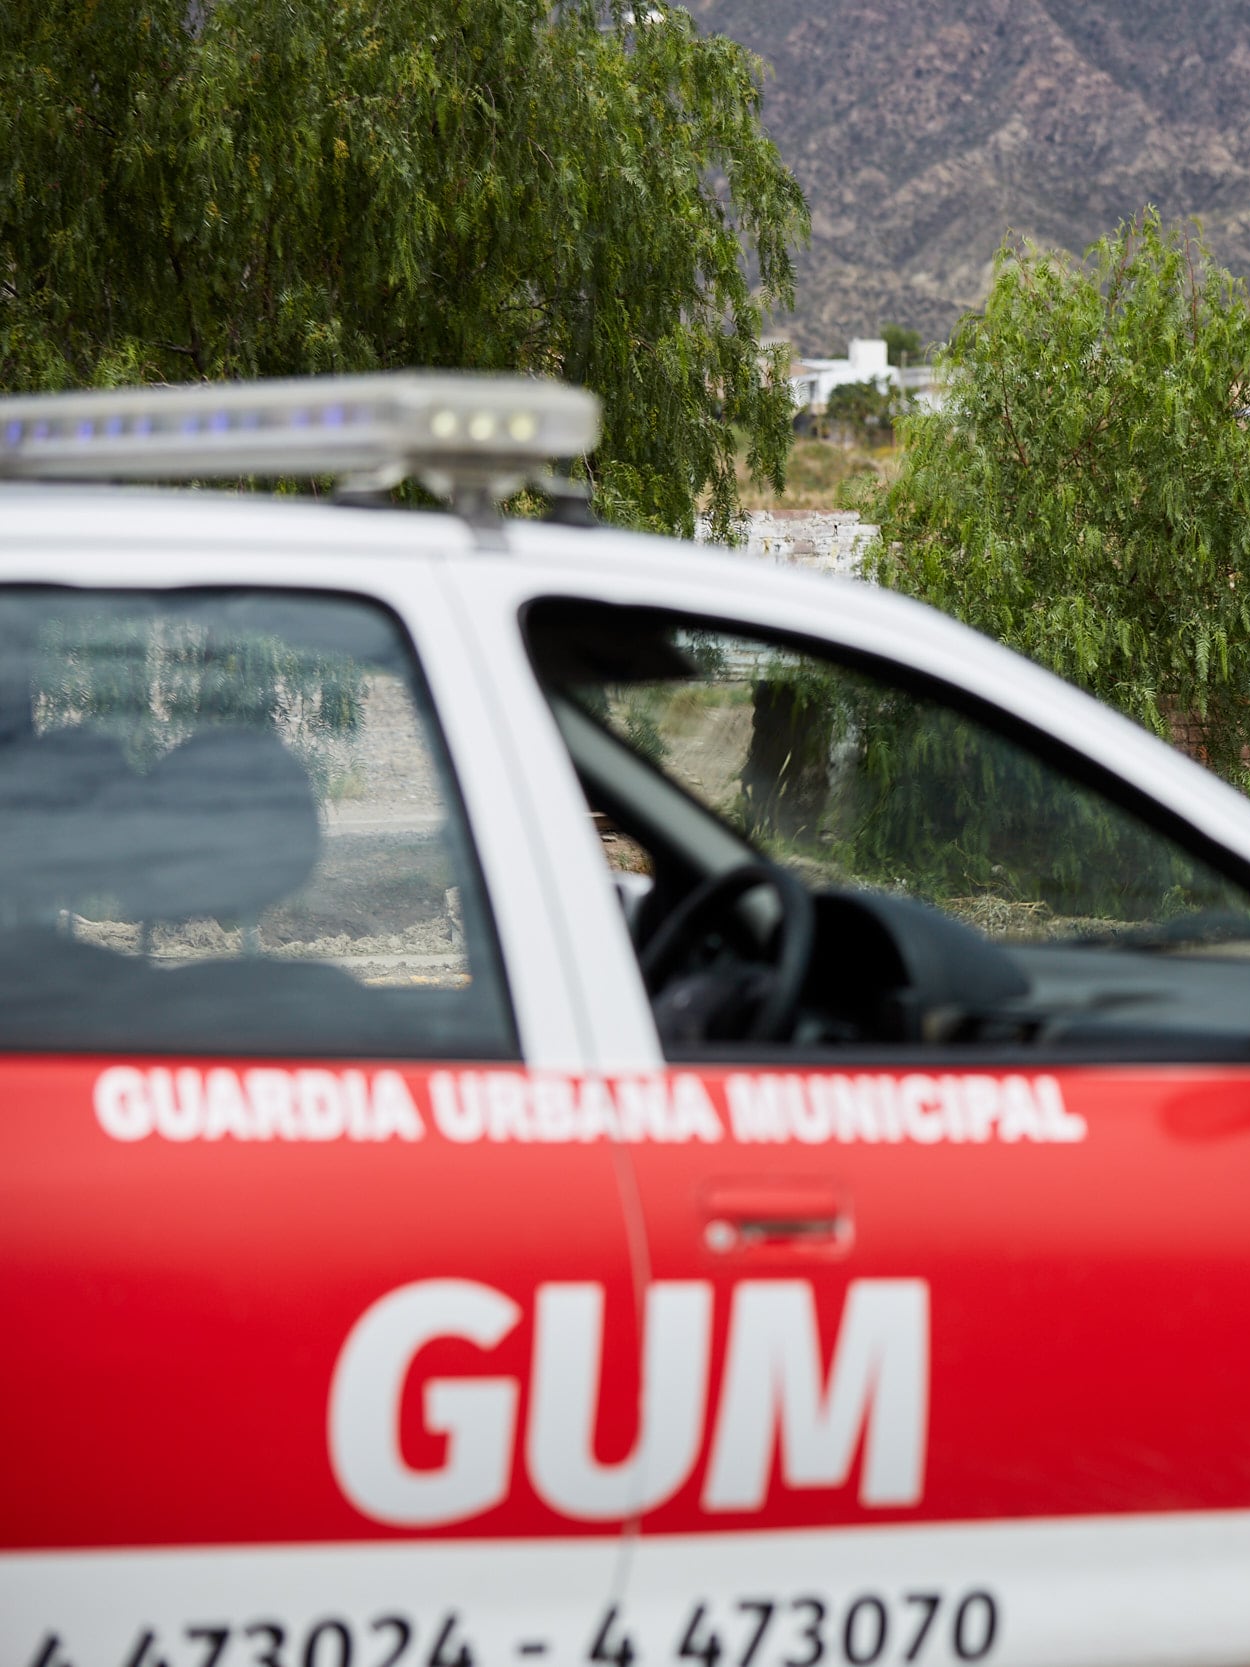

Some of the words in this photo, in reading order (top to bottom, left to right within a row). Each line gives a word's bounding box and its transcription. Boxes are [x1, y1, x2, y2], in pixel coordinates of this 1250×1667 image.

[94, 1066, 424, 1142] GUARDIA
[428, 1070, 724, 1143] URBANA
[727, 1074, 1087, 1143] MUNICIPAL
[328, 1278, 930, 1527] GUM
[587, 1601, 636, 1667] 4
[676, 1589, 1003, 1667] 473070
